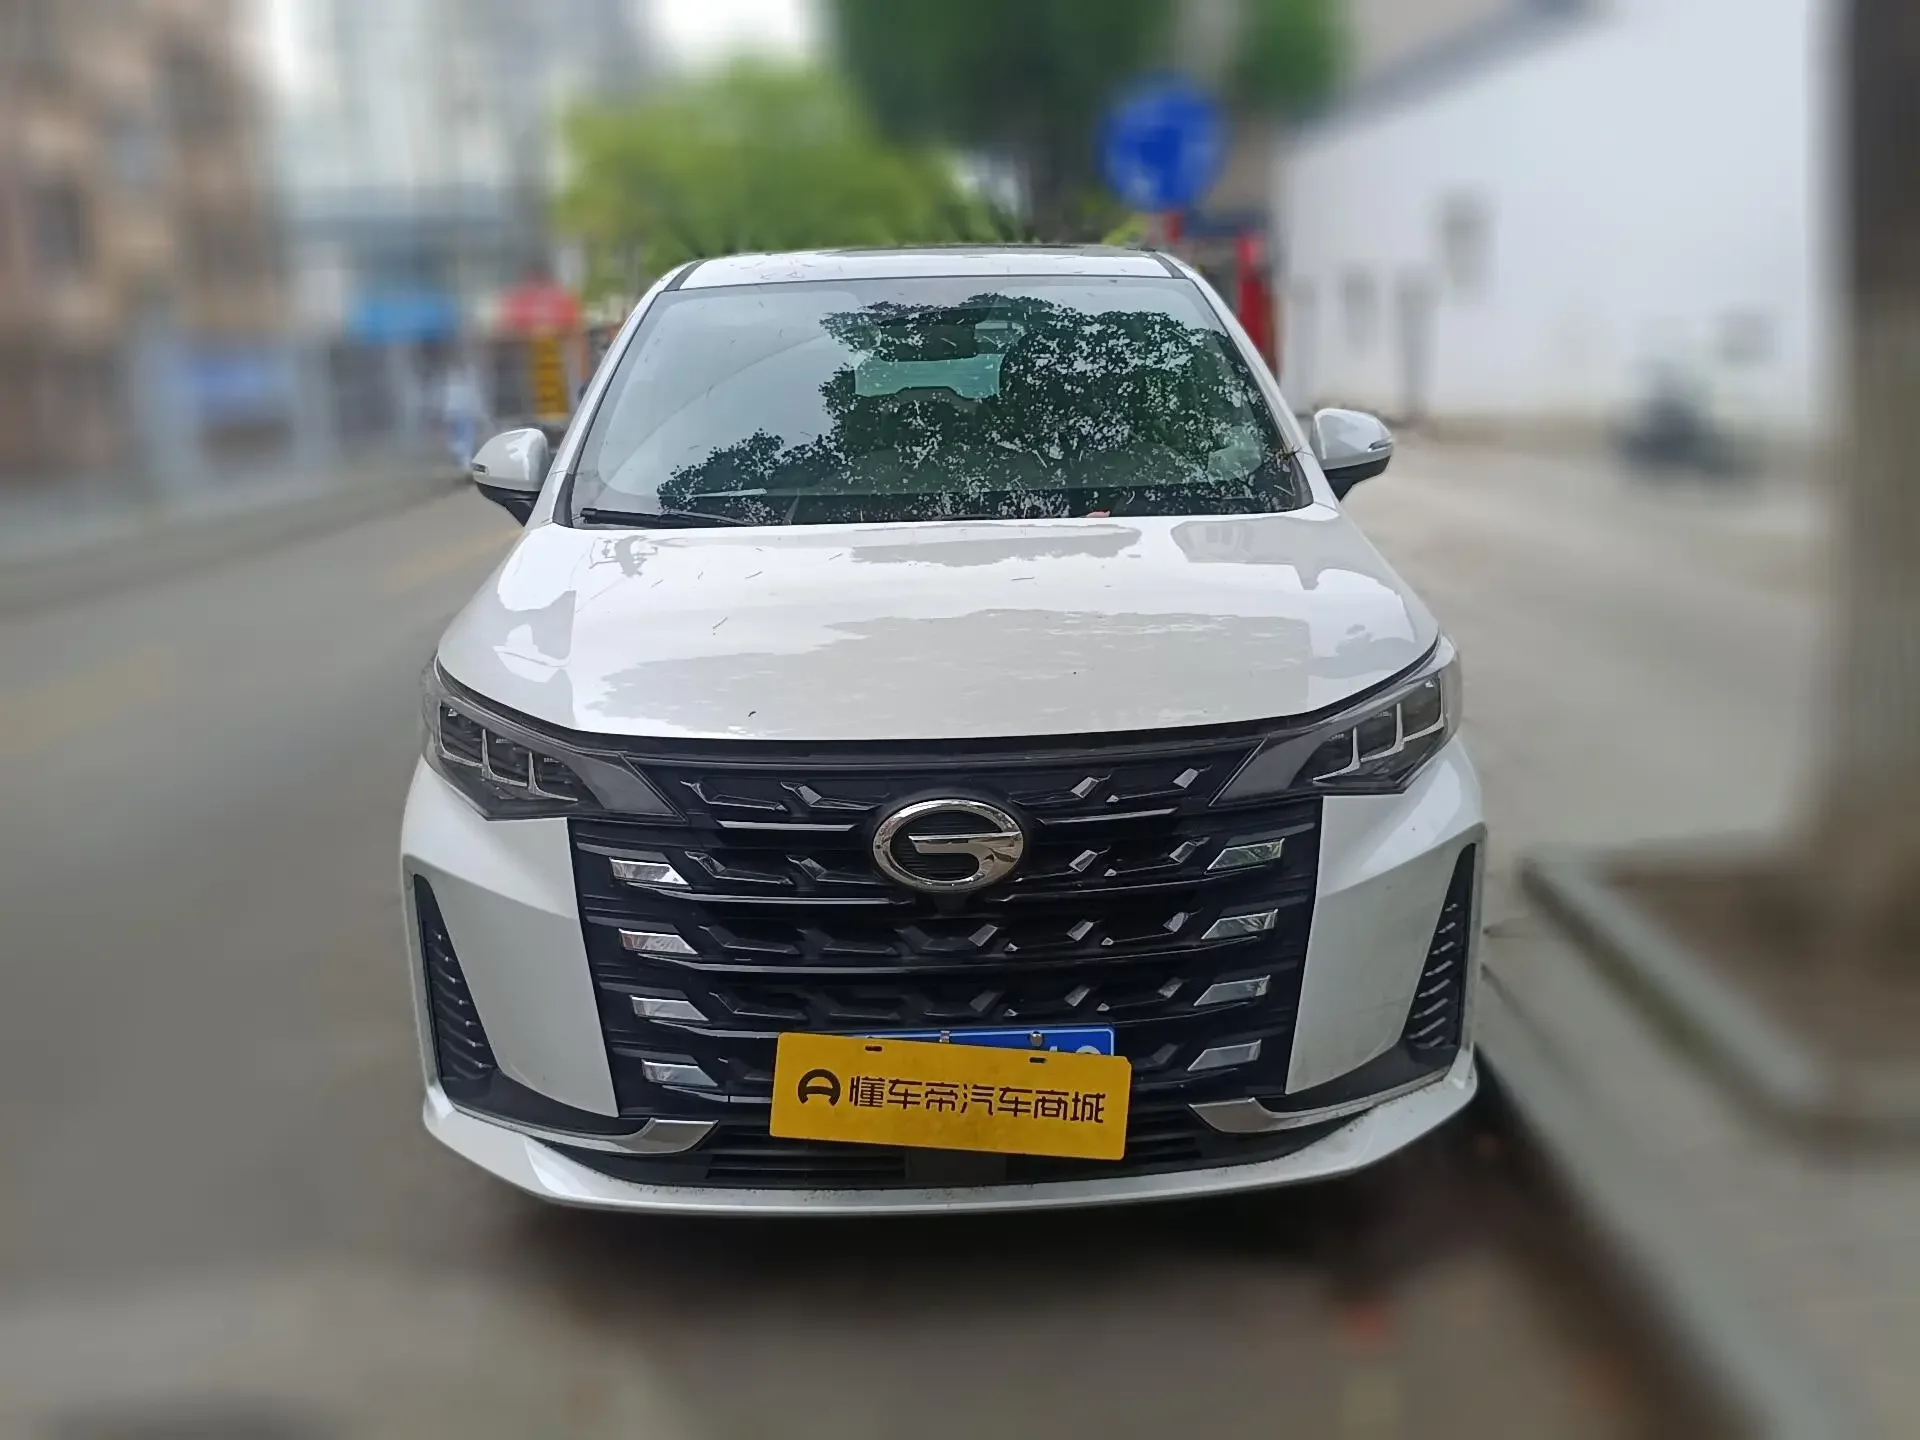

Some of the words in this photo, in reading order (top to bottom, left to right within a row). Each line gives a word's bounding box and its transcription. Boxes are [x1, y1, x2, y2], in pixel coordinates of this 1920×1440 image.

[849, 1075, 1106, 1124] 懂车帝汽车商城
